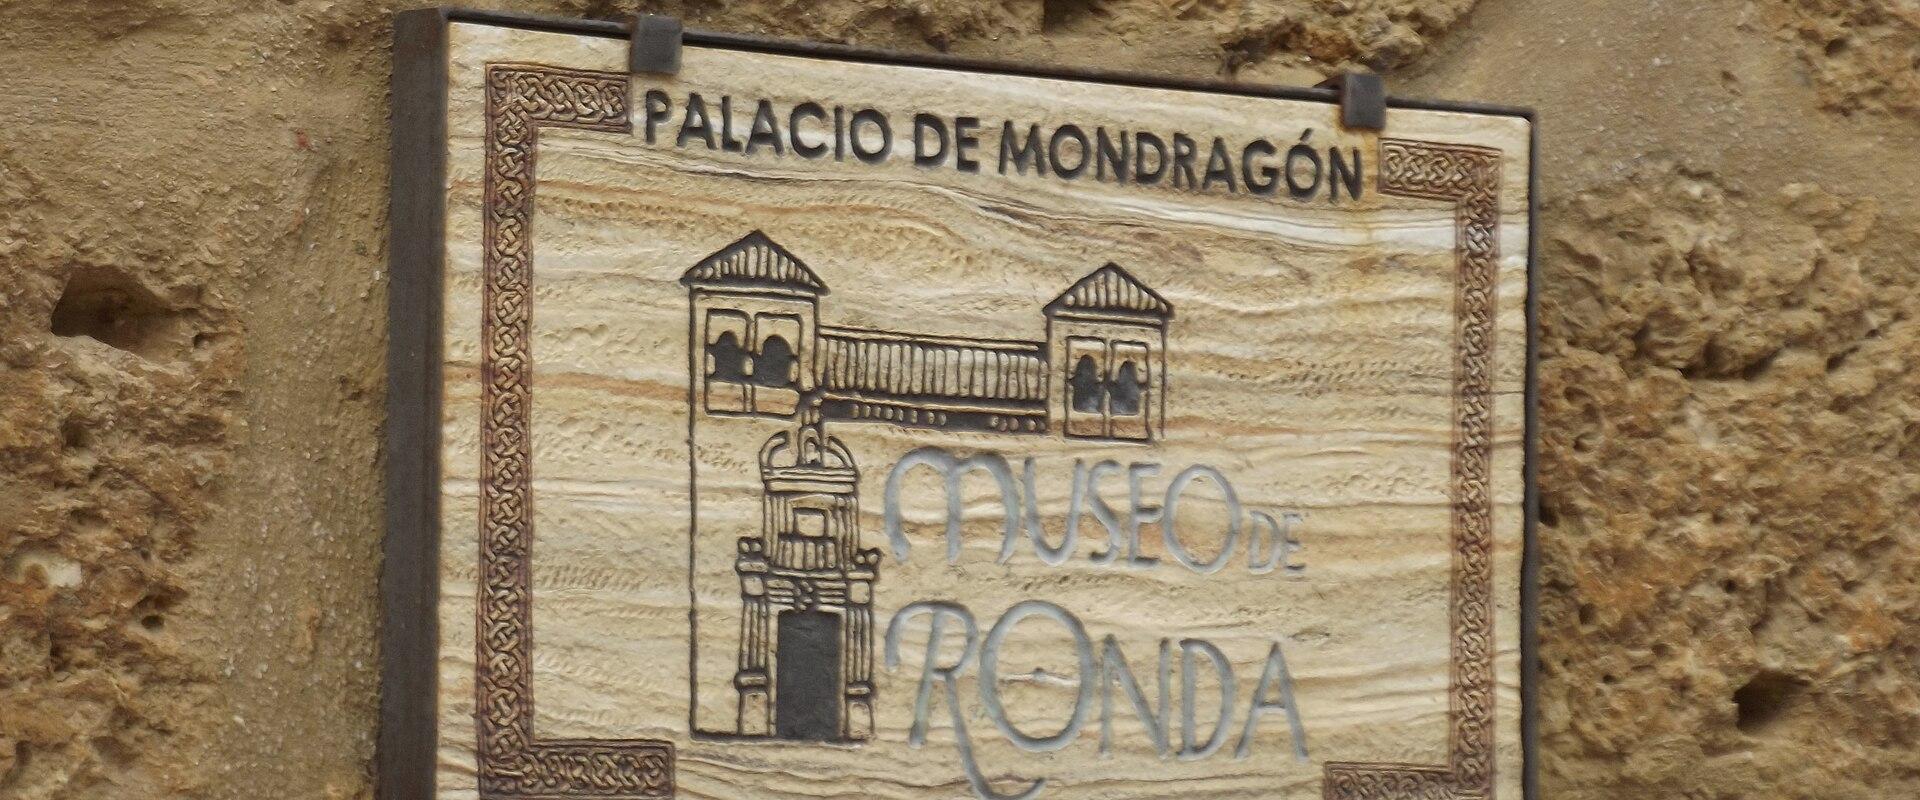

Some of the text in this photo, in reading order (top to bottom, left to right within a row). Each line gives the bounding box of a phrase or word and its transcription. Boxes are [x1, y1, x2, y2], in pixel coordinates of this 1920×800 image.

[644, 89, 1364, 201] PALACIO DE MONDRAGÓN
[884, 445, 1306, 575] MUSEO DE
[884, 599, 1308, 800] RONDA
